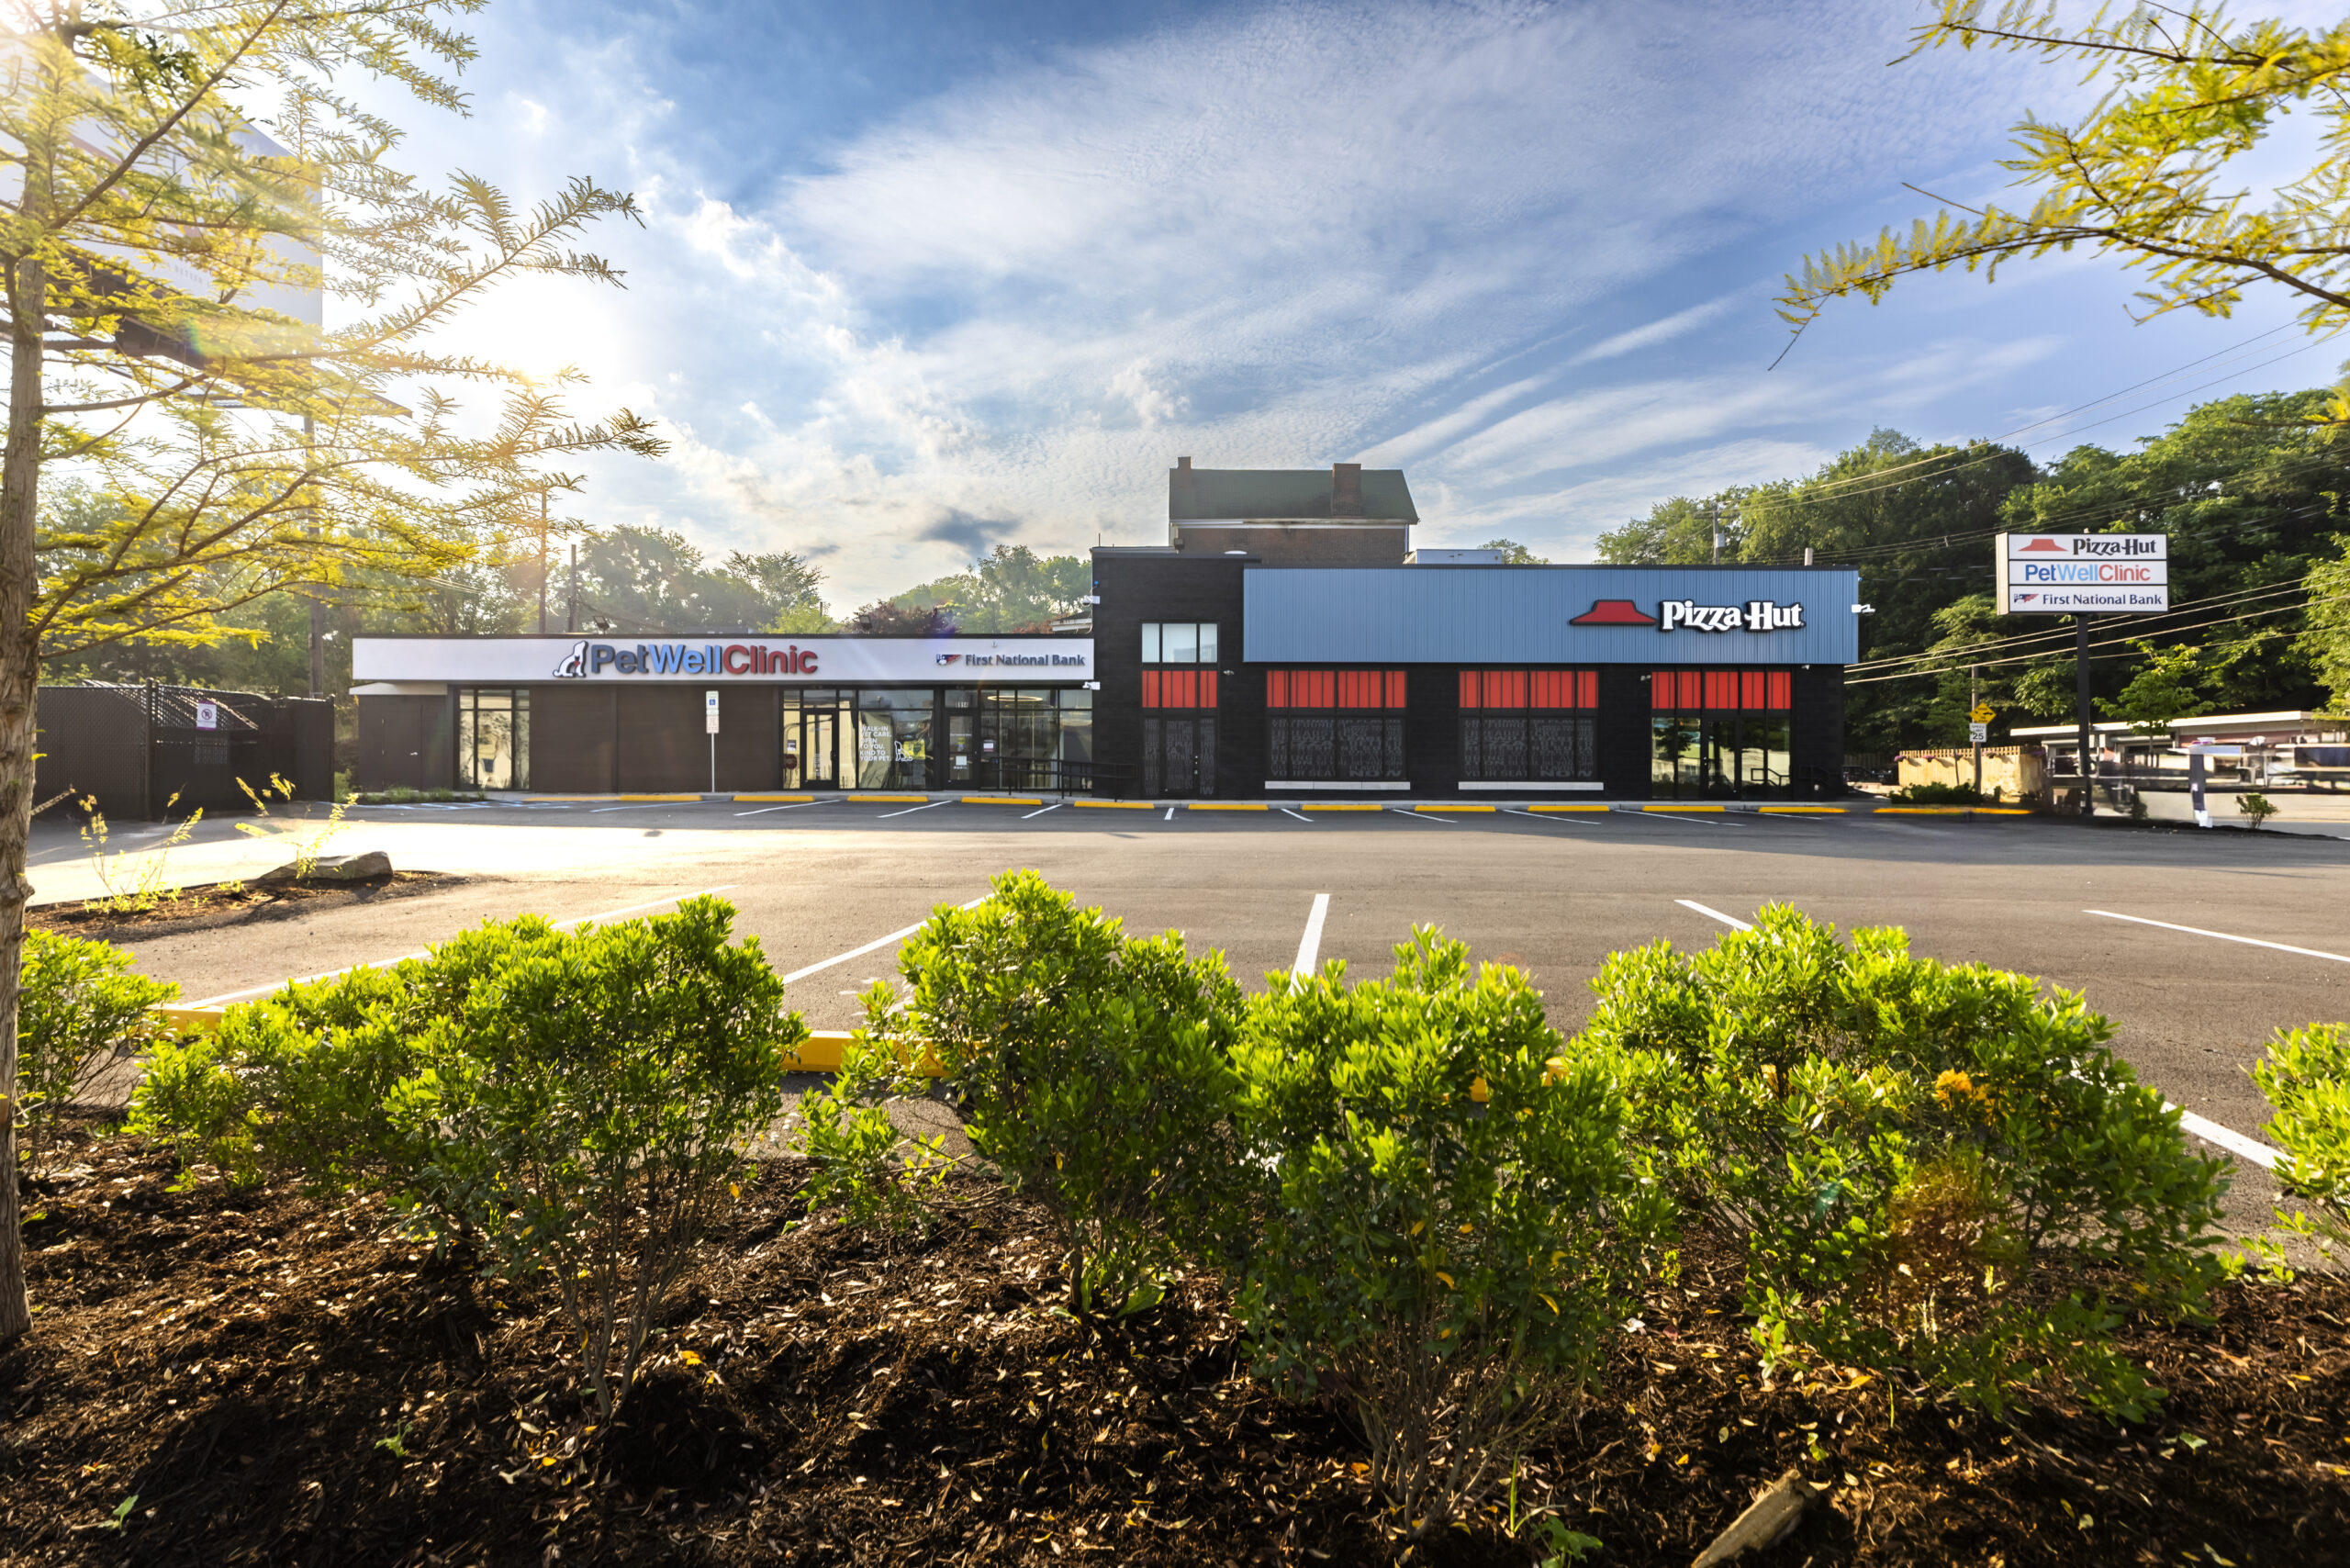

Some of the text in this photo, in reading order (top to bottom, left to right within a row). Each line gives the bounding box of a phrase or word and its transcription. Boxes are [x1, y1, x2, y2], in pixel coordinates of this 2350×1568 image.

[2073, 538, 2156, 556] Pizza Hut
[2025, 564, 2151, 582] PetWellClinic
[2042, 594, 2162, 605] First National Bank
[1660, 599, 1803, 632] Pizza Hut
[590, 644, 818, 675] PetWellClinic
[966, 654, 1086, 666] First National Bank
